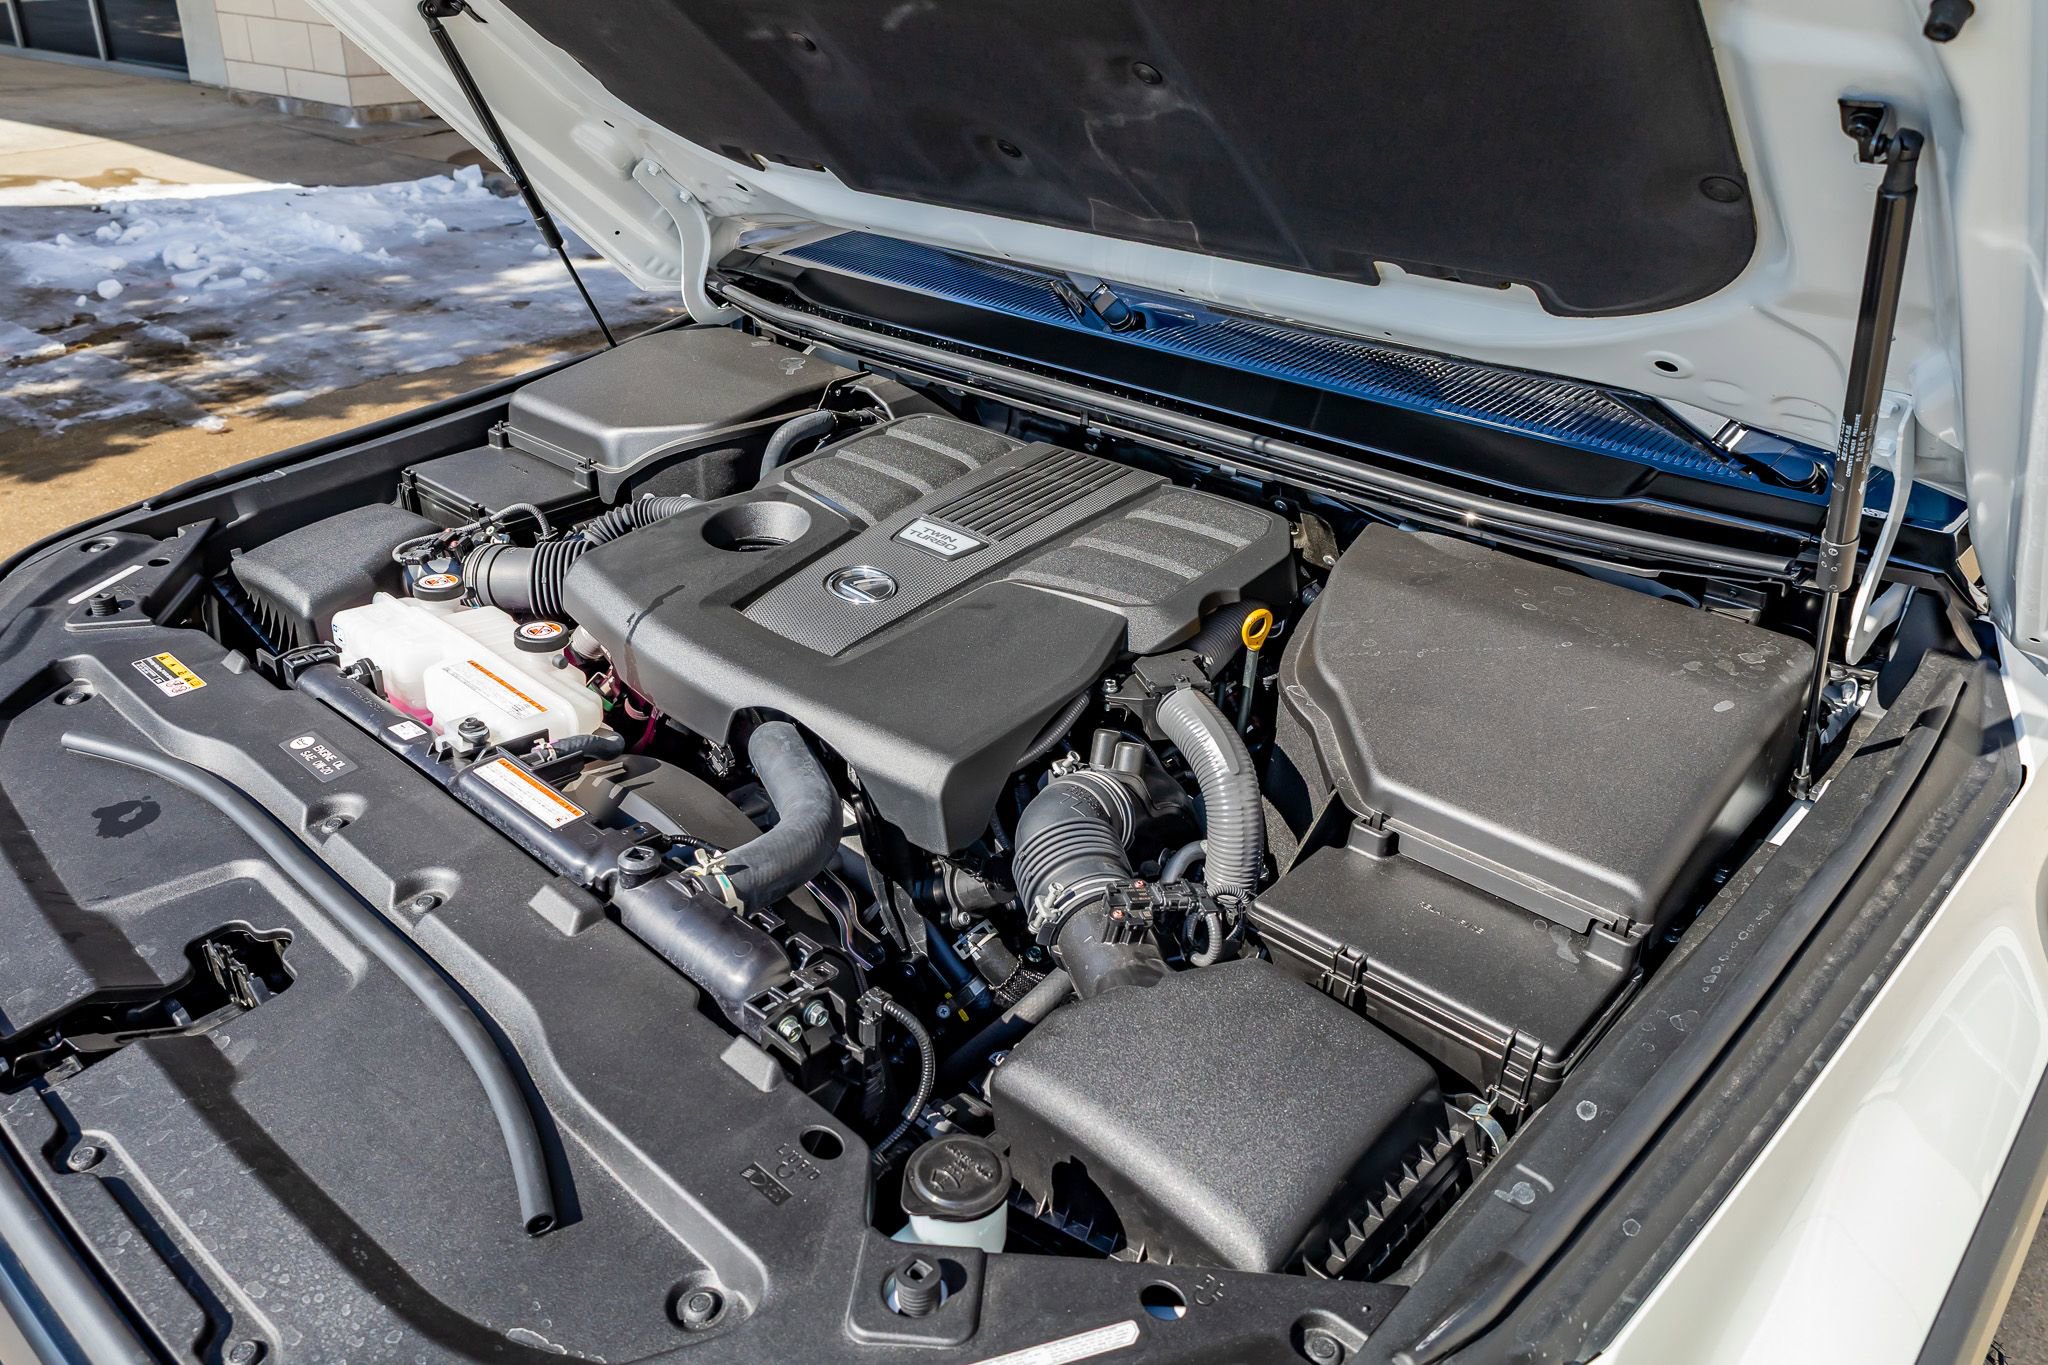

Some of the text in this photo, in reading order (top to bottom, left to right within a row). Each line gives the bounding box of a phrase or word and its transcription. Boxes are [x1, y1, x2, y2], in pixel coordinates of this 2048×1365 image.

[909, 528, 958, 551] TURBO
[923, 526, 957, 543] TWIN
[299, 750, 318, 762] SAE
[312, 744, 346, 771] ENGINE OIL
